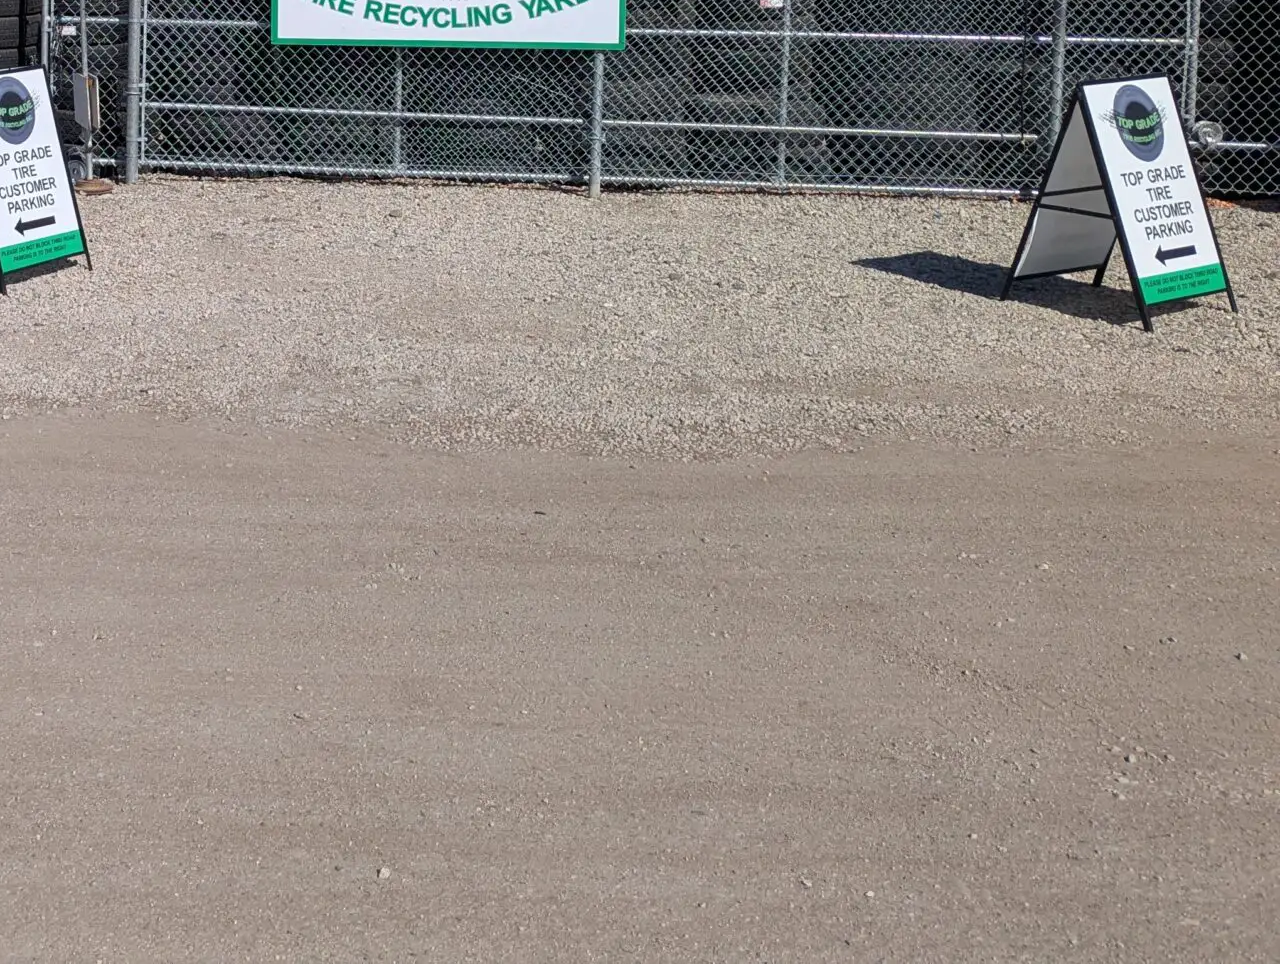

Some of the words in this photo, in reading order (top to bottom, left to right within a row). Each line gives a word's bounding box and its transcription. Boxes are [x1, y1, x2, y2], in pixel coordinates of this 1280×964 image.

[363, 0, 513, 29] RECYCLING
[8, 99, 33, 117] GRADE
[1116, 116, 1134, 130] TOP
[1135, 111, 1160, 130] GRADE
[14, 145, 53, 164] GRADE
[11, 164, 38, 180] TIRE
[1120, 170, 1144, 187] TOP
[1147, 164, 1186, 183] GRADE
[1145, 185, 1173, 202] TIRE
[7, 193, 55, 215] PARKING
[1133, 200, 1194, 223] CUSTOMER
[1144, 219, 1194, 241] PARKING
